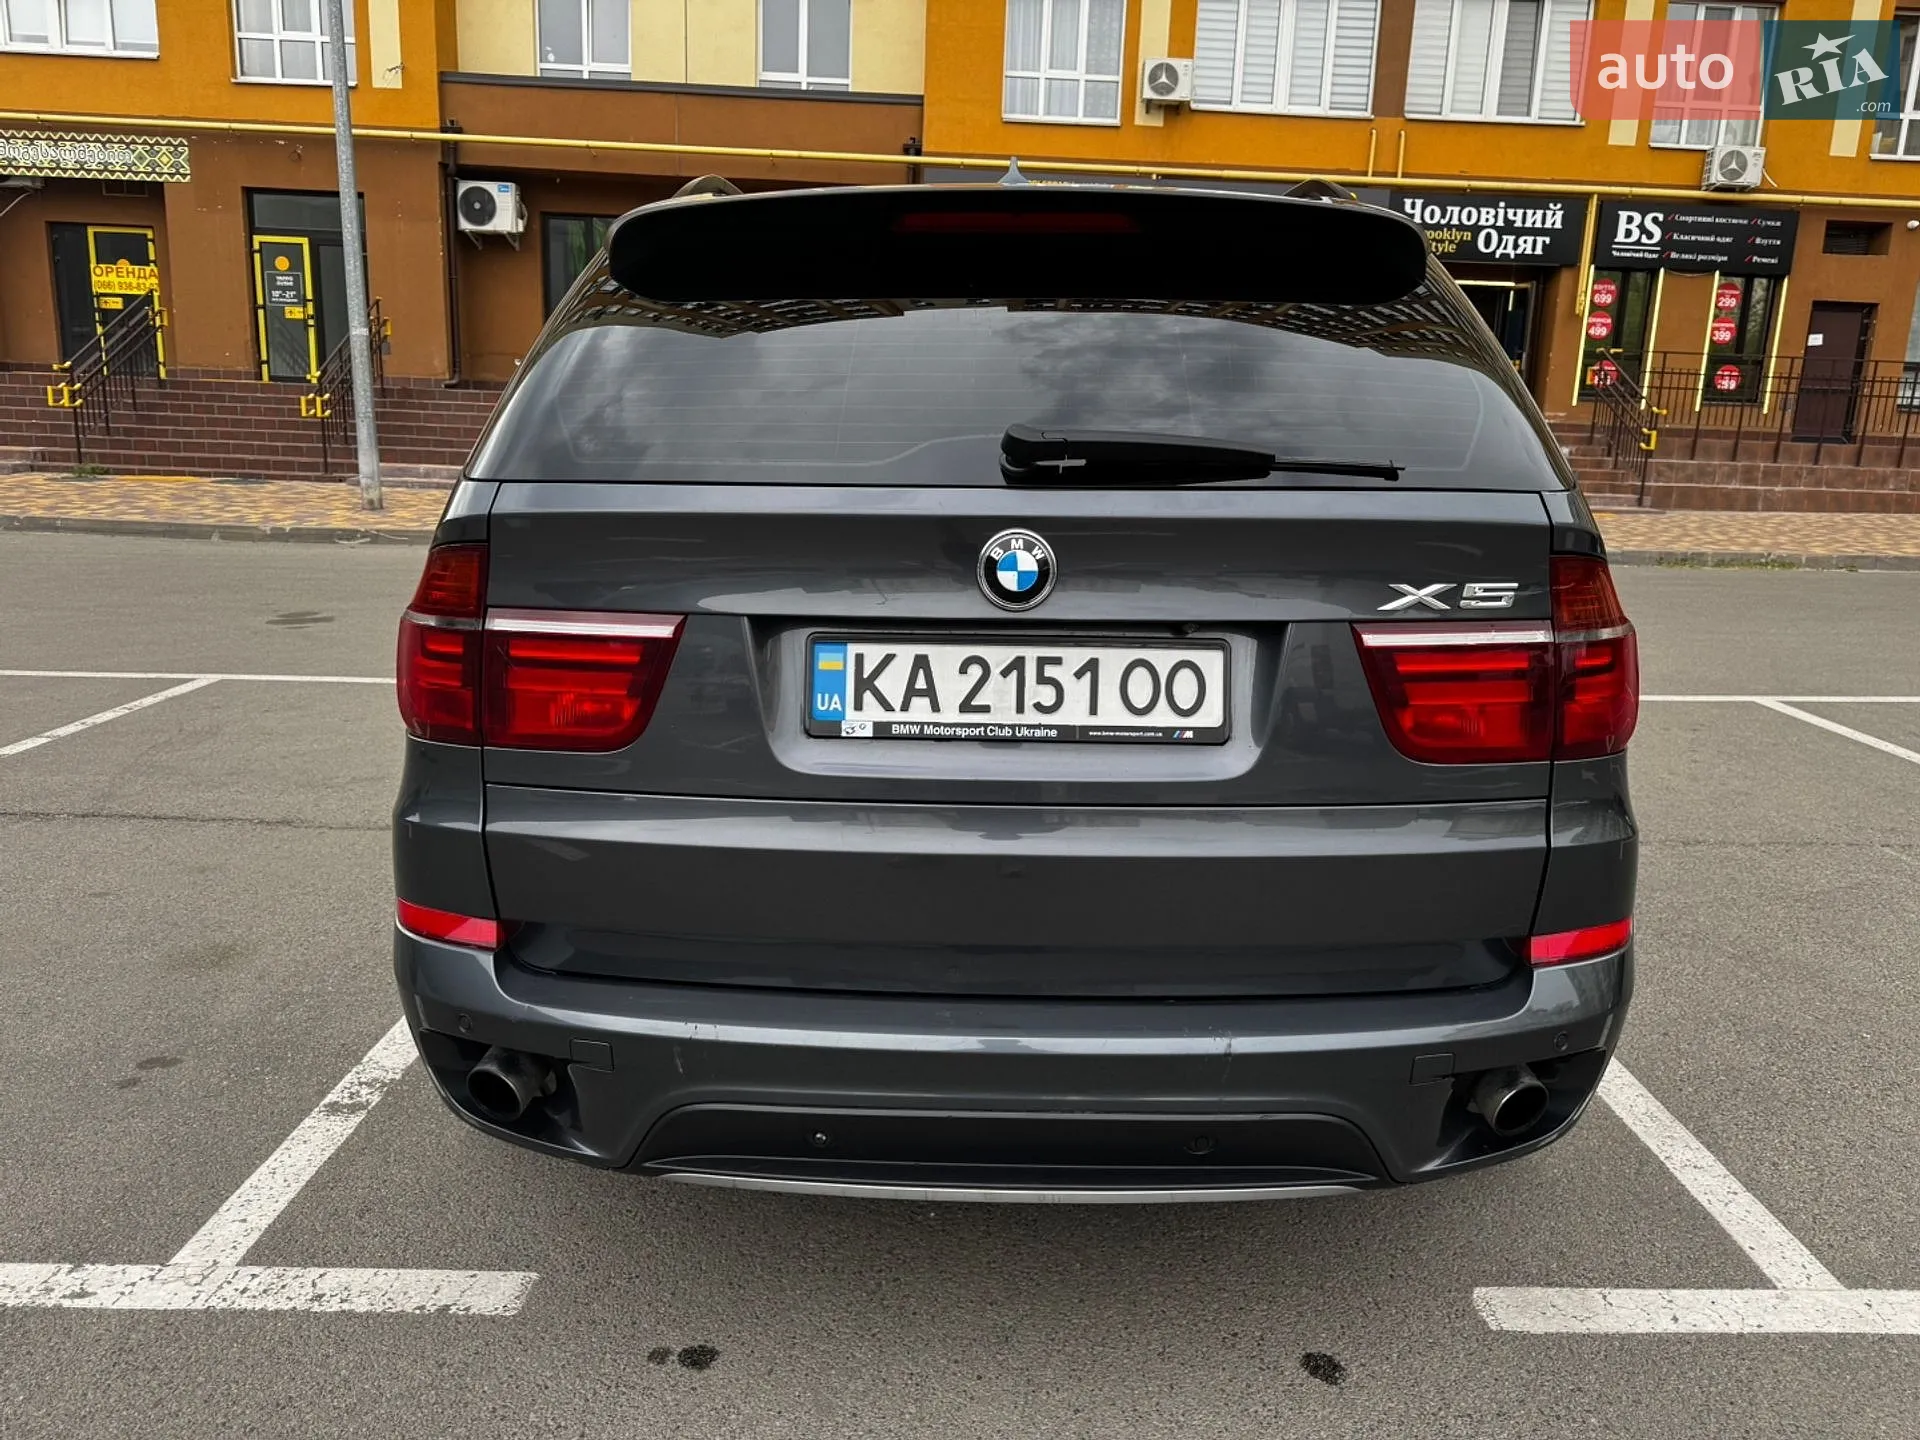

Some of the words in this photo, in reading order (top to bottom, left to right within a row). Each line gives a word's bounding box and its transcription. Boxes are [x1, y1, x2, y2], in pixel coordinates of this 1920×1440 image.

[1403, 198, 1564, 229] Чоловічий
[1424, 227, 1472, 243] ooklyn
[1614, 210, 1664, 244] BS
[1429, 240, 1457, 255] tyle
[1477, 228, 1550, 259] Одяг
[93, 265, 159, 280] ОРЕНДА
[1594, 293, 1612, 304] 699
[1717, 297, 1736, 308] 299
[1588, 326, 1607, 337] 499
[1711, 330, 1731, 341] 399
[989, 538, 1045, 561] BMW
[1376, 582, 1519, 611] X5
[853, 652, 941, 713] KA
[958, 654, 1099, 716] 2151
[1119, 657, 1207, 717] OO
[817, 693, 842, 711] UA
[891, 724, 920, 735] BMW
[923, 725, 985, 739] Motorsport
[986, 726, 1013, 737] Club
[1015, 726, 1058, 738] Ukraine
